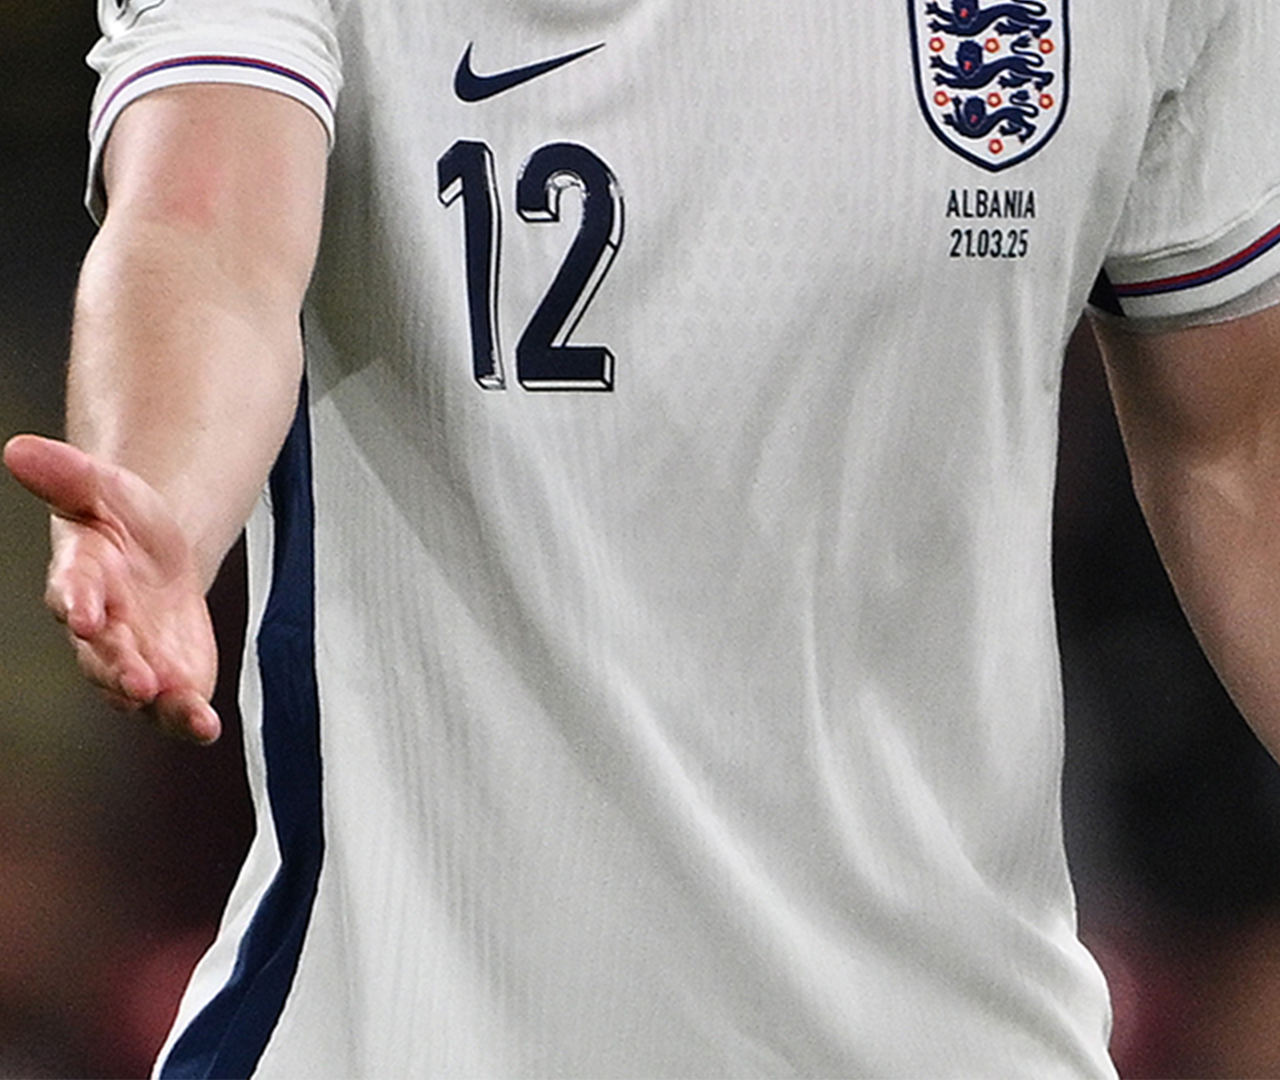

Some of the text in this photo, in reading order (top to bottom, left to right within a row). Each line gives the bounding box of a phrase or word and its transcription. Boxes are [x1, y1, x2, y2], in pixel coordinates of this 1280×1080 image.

[946, 189, 1036, 219] ALBANIA
[950, 229, 1028, 258] 21.03.25
[437, 140, 625, 391] 12
